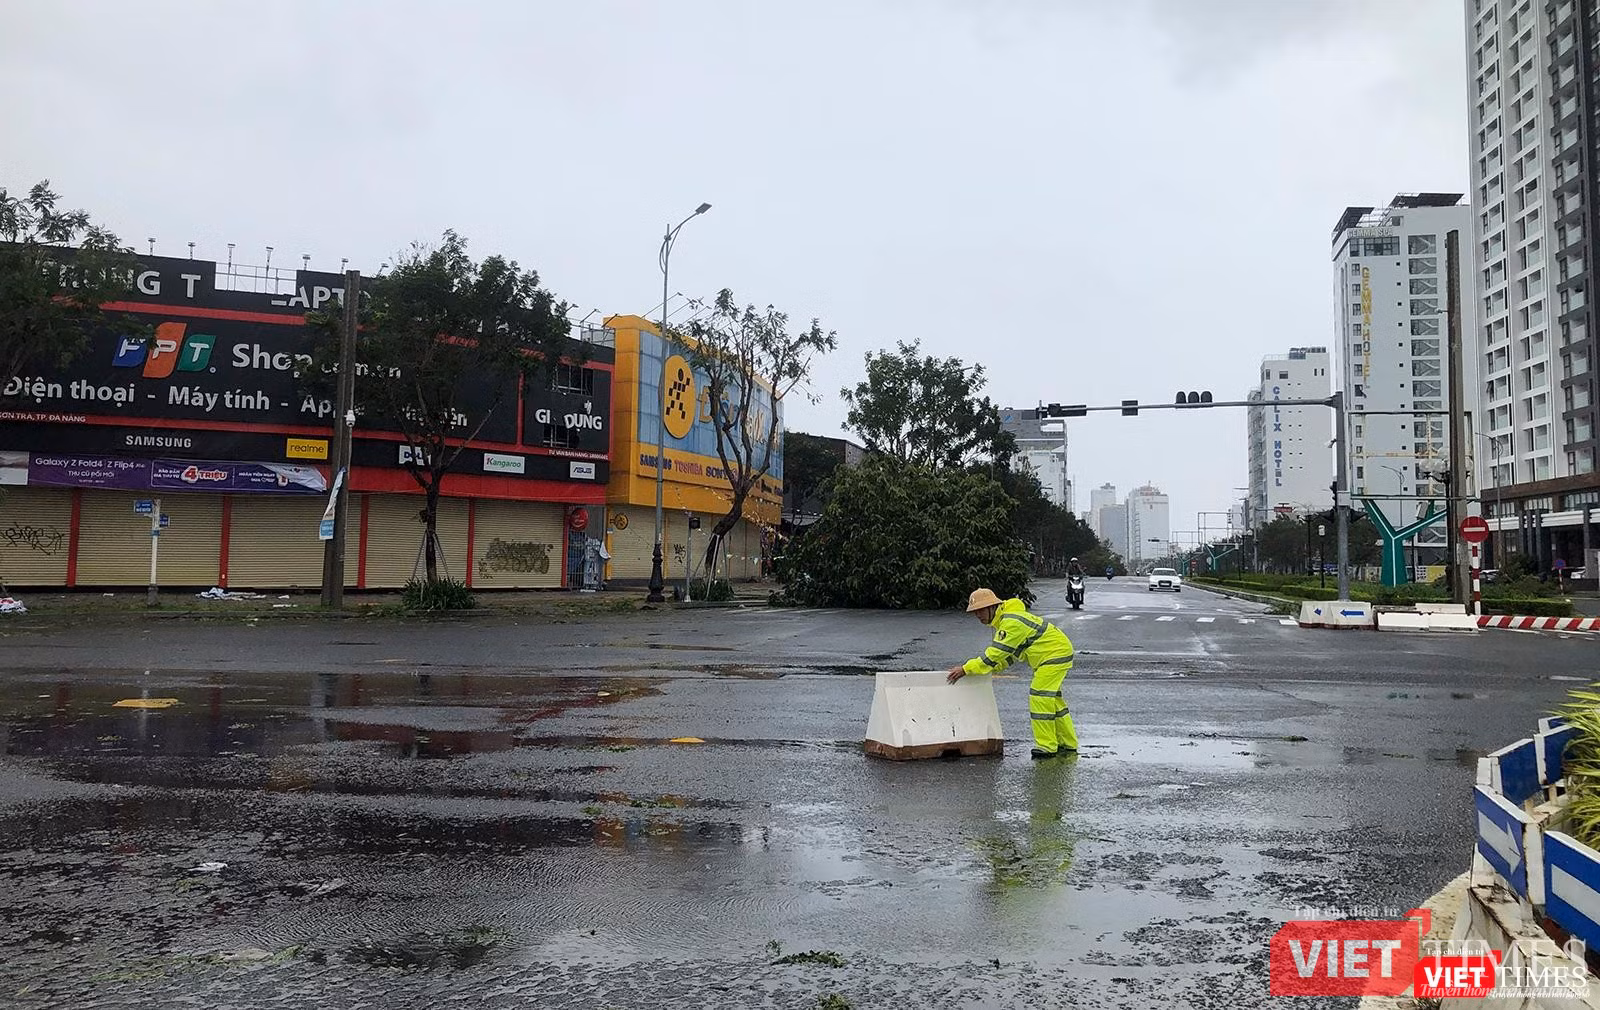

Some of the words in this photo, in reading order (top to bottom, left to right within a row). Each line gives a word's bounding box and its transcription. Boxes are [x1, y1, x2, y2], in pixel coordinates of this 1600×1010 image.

[70, 381, 135, 408] thoại
[168, 386, 218, 412] Máy
[224, 389, 270, 411] tính
[126, 435, 192, 448] SAMSUNG
[290, 444, 325, 453] realme
[35, 457, 69, 468] Galaxy
[71, 459, 77, 467] Z
[78, 460, 103, 468] Fold4
[107, 461, 113, 469] Z
[114, 461, 134, 470] Flip4
[486, 455, 521, 468] Kangaroo
[639, 454, 672, 471] SAMSNG
[674, 460, 704, 476] TOSHIBA
[1274, 440, 1282, 486] HOTEL
[183, 466, 199, 482] 4
[199, 470, 229, 482] TRIỆU
